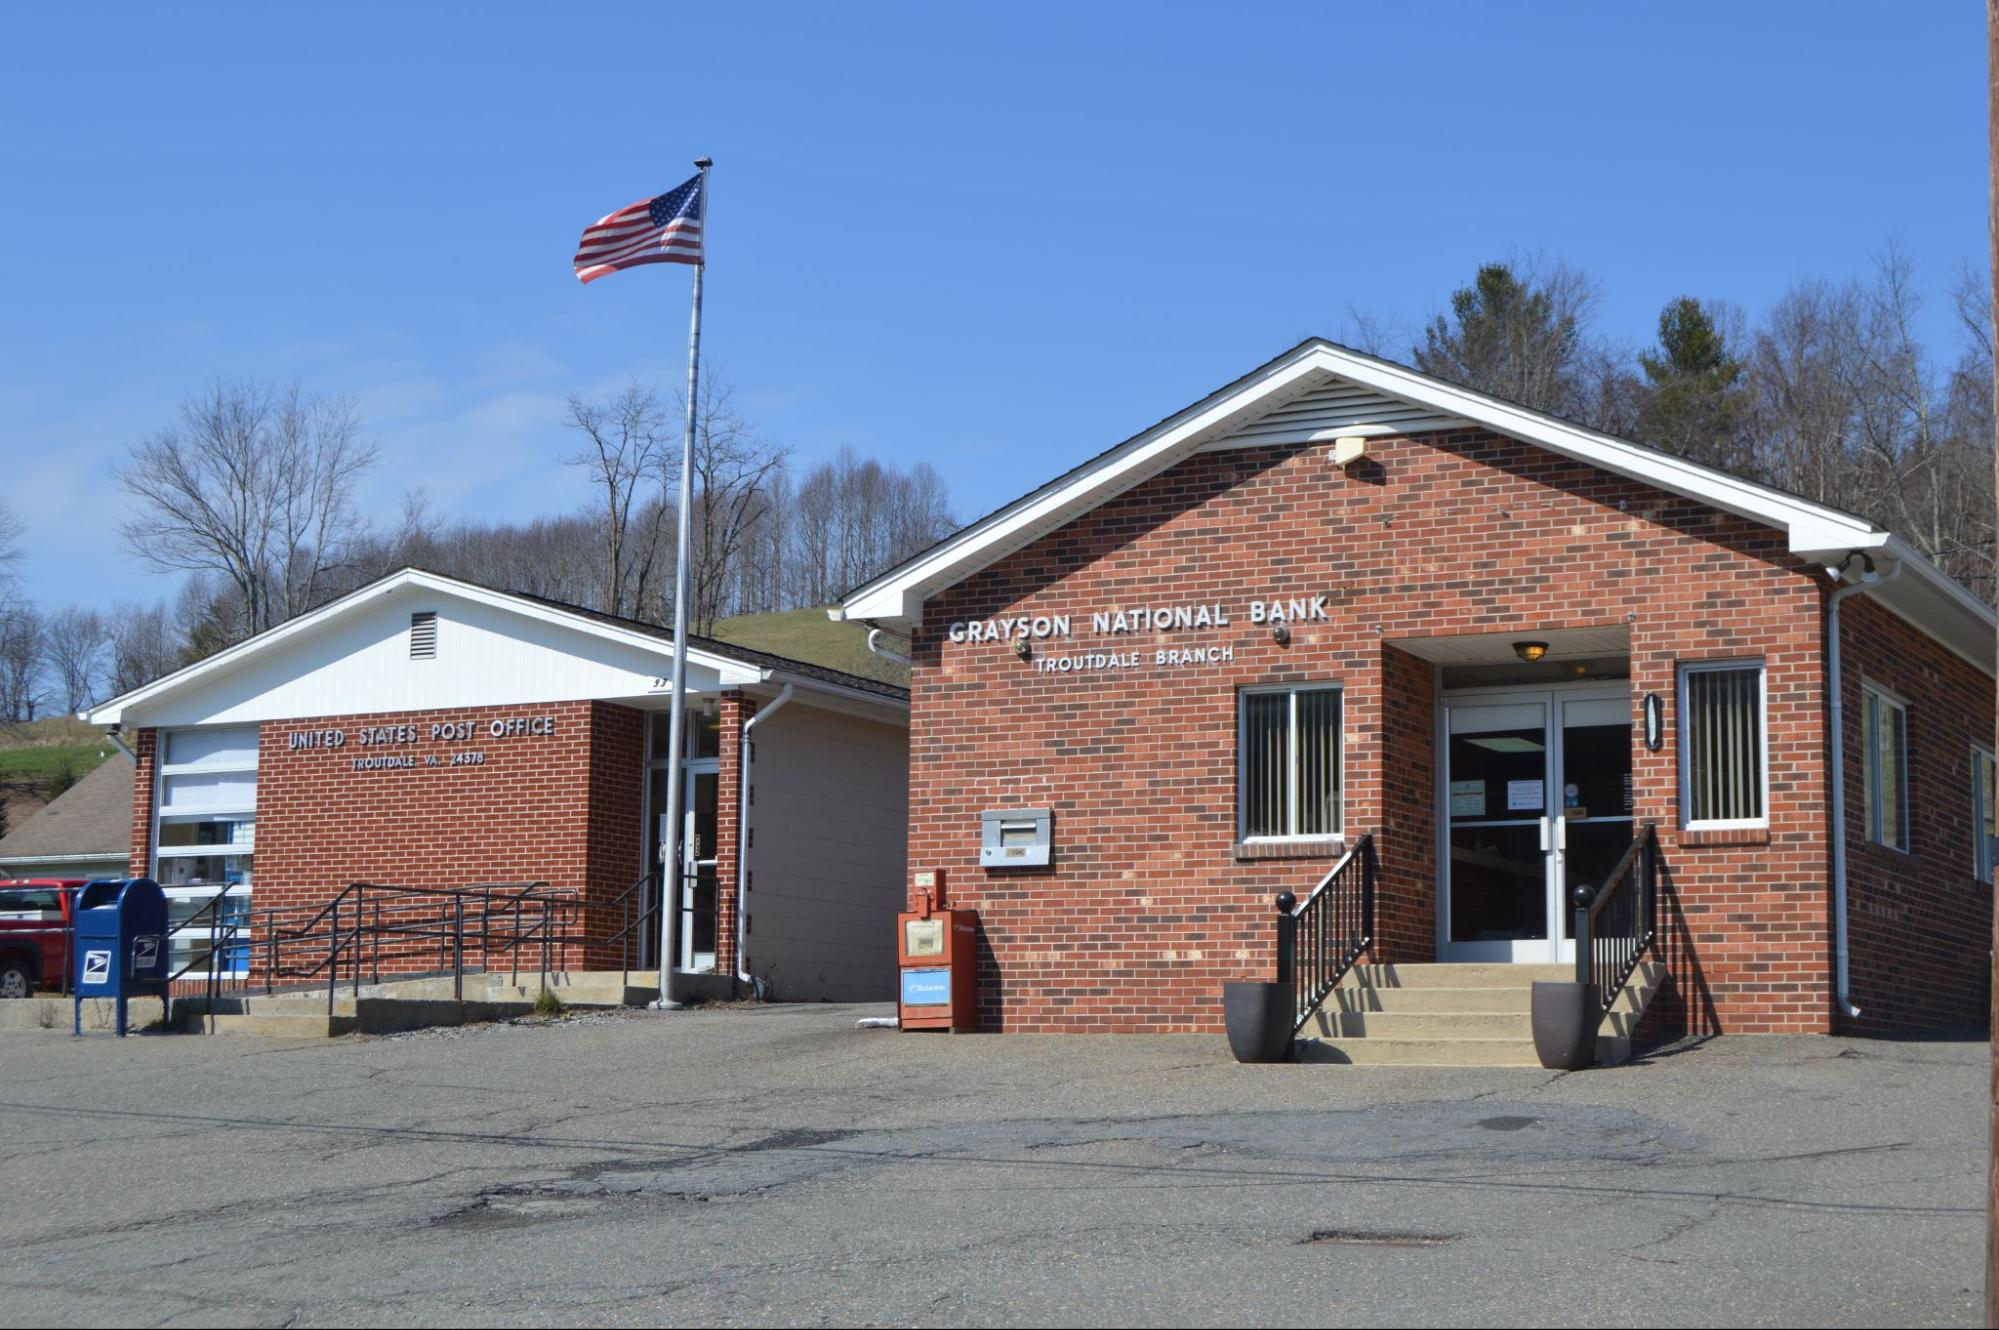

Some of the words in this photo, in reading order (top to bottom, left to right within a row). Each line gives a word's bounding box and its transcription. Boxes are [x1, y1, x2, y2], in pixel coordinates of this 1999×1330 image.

[949, 614, 1071, 644] GRAYSON
[1092, 604, 1229, 634] NATIONAL
[1250, 596, 1329, 623] BANK
[1036, 652, 1140, 673] TROUTDALE
[1156, 646, 1235, 666] BRANCH
[288, 731, 345, 751] UNITED
[359, 724, 417, 745] STATES
[431, 721, 476, 741] POST
[490, 716, 555, 738] OFFICE
[450, 751, 485, 767] 24378
